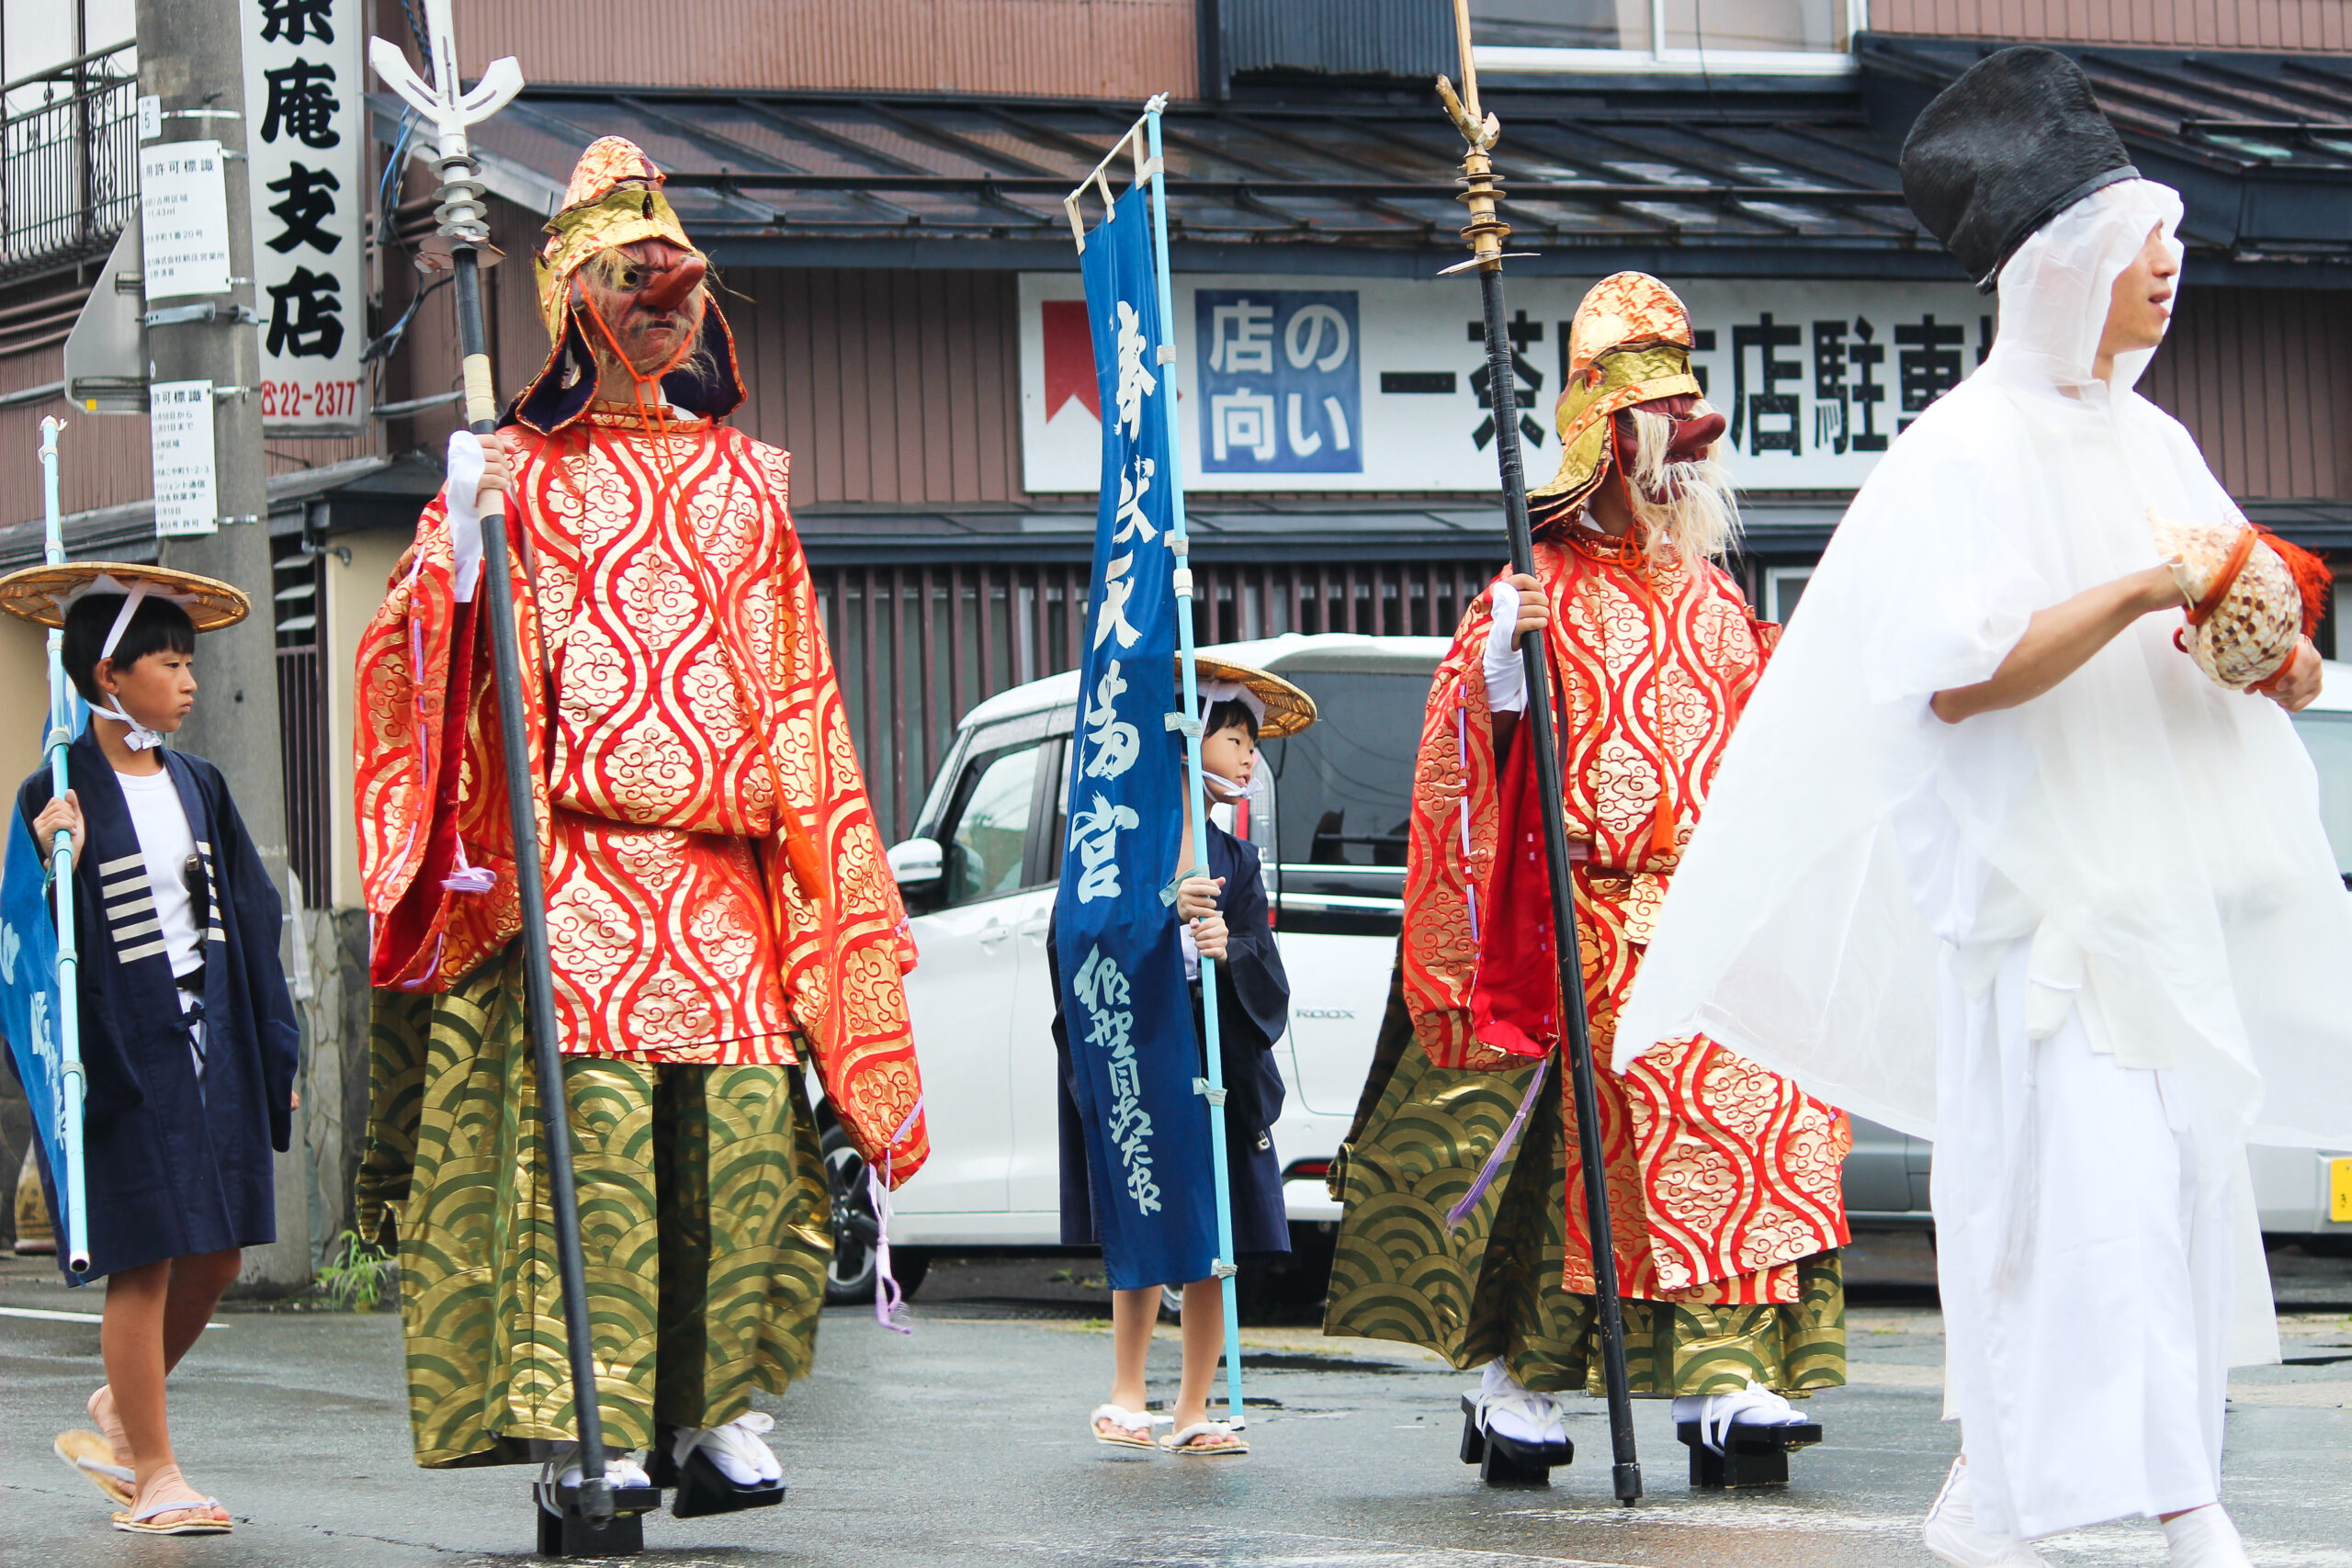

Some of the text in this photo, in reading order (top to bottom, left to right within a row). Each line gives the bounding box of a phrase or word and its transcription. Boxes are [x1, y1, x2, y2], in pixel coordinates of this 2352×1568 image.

[1209, 299, 1351, 375] 店の
[280, 381, 356, 416] 22-2377
[1380, 310, 1999, 457] 一茶店駐車
[1211, 388, 1351, 461] 向い
